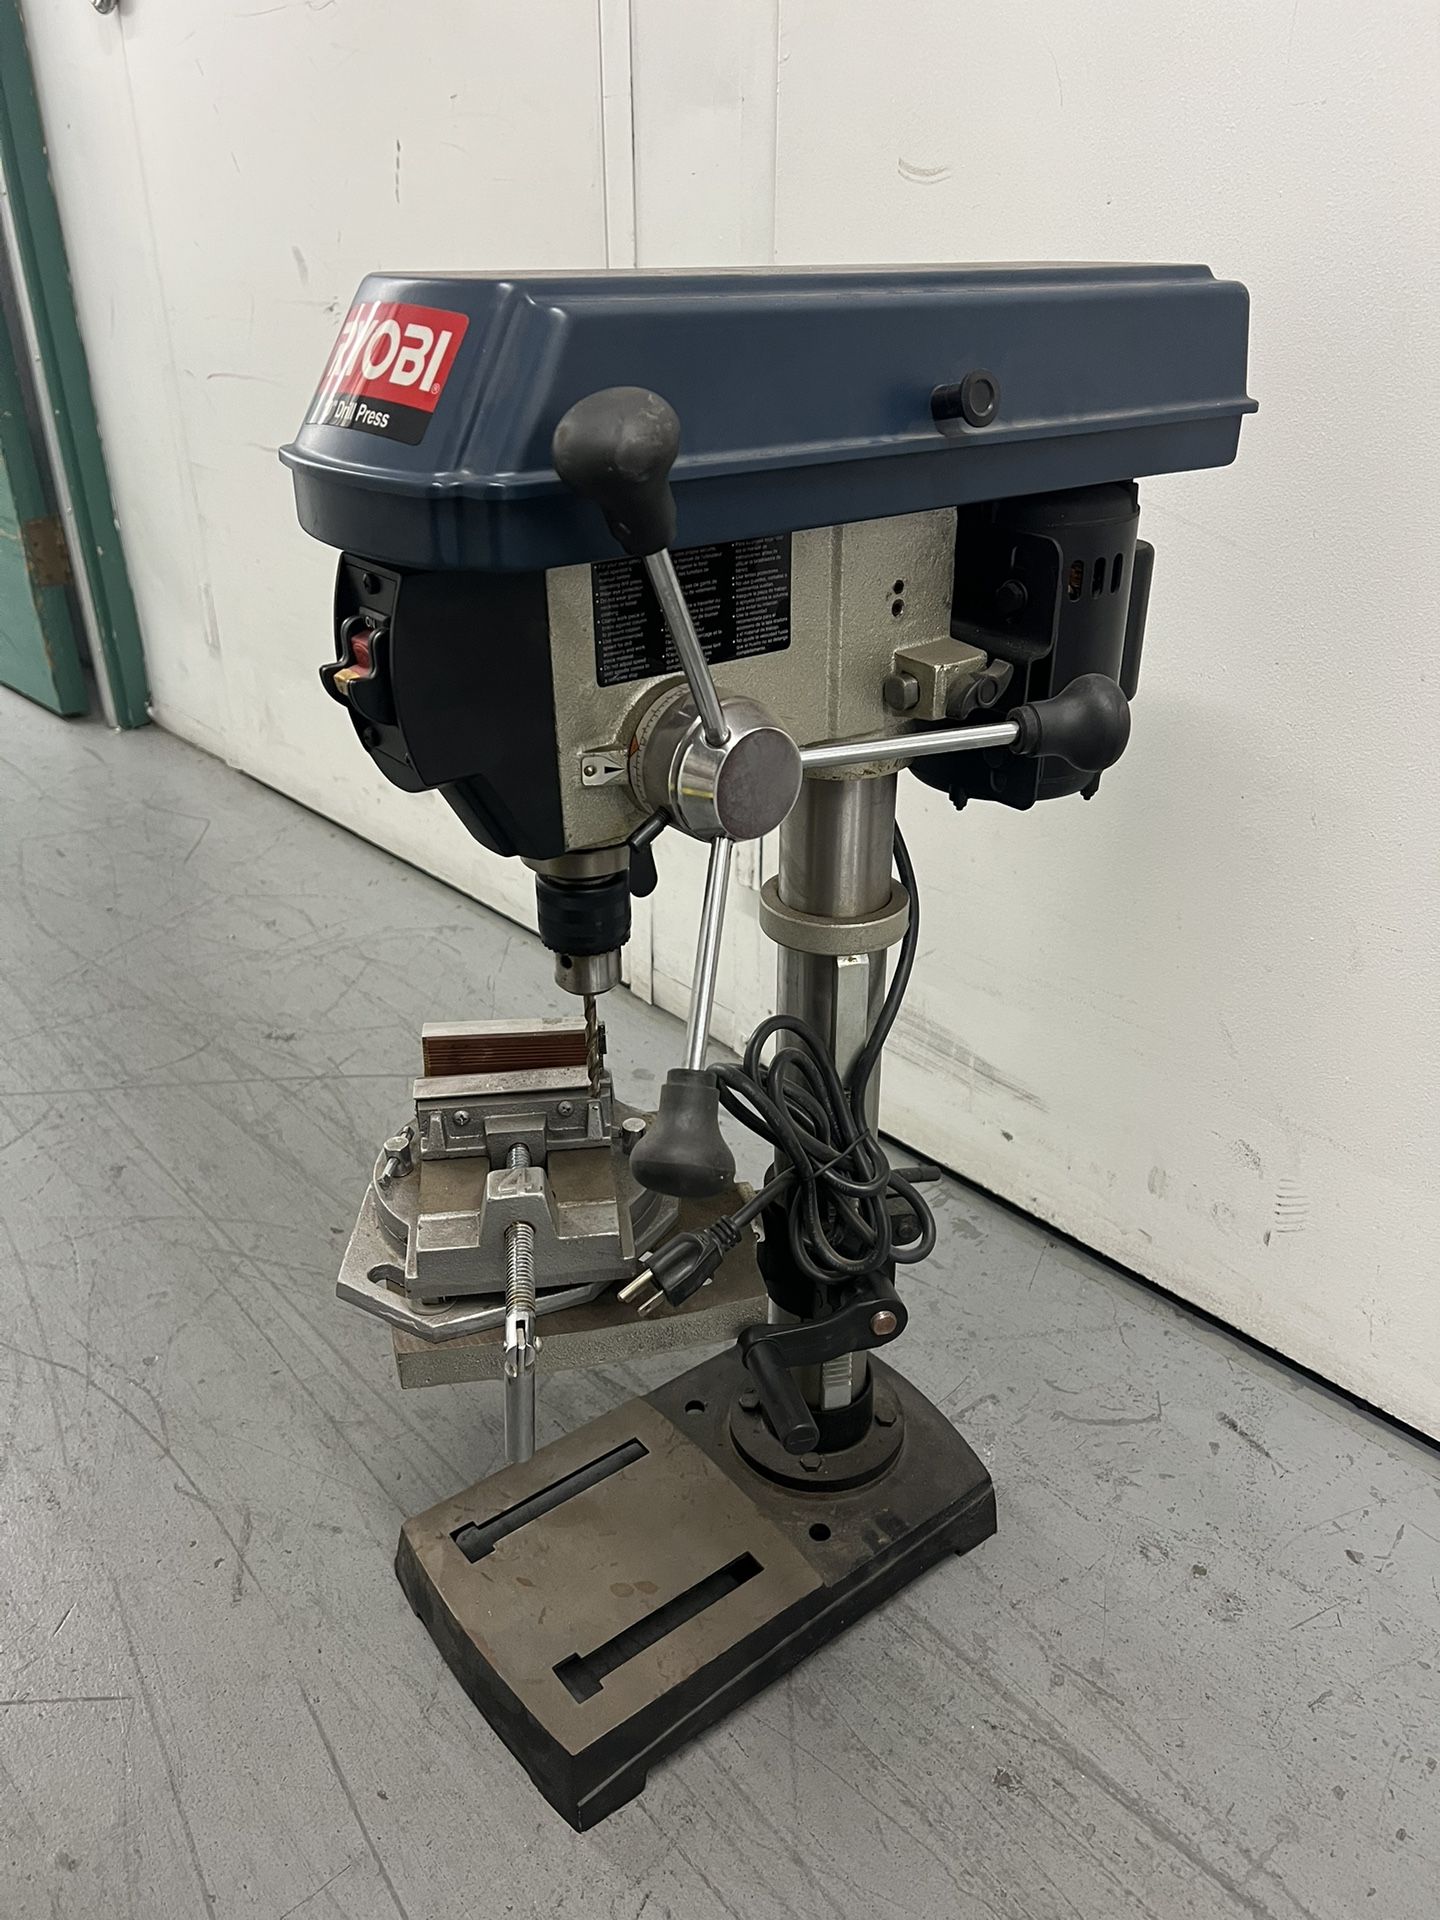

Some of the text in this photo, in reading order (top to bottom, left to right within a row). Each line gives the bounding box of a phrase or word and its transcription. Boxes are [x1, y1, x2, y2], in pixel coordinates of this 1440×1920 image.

[334, 400, 357, 420] Drill
[355, 403, 390, 428] Press
[498, 1168, 533, 1195] 4
